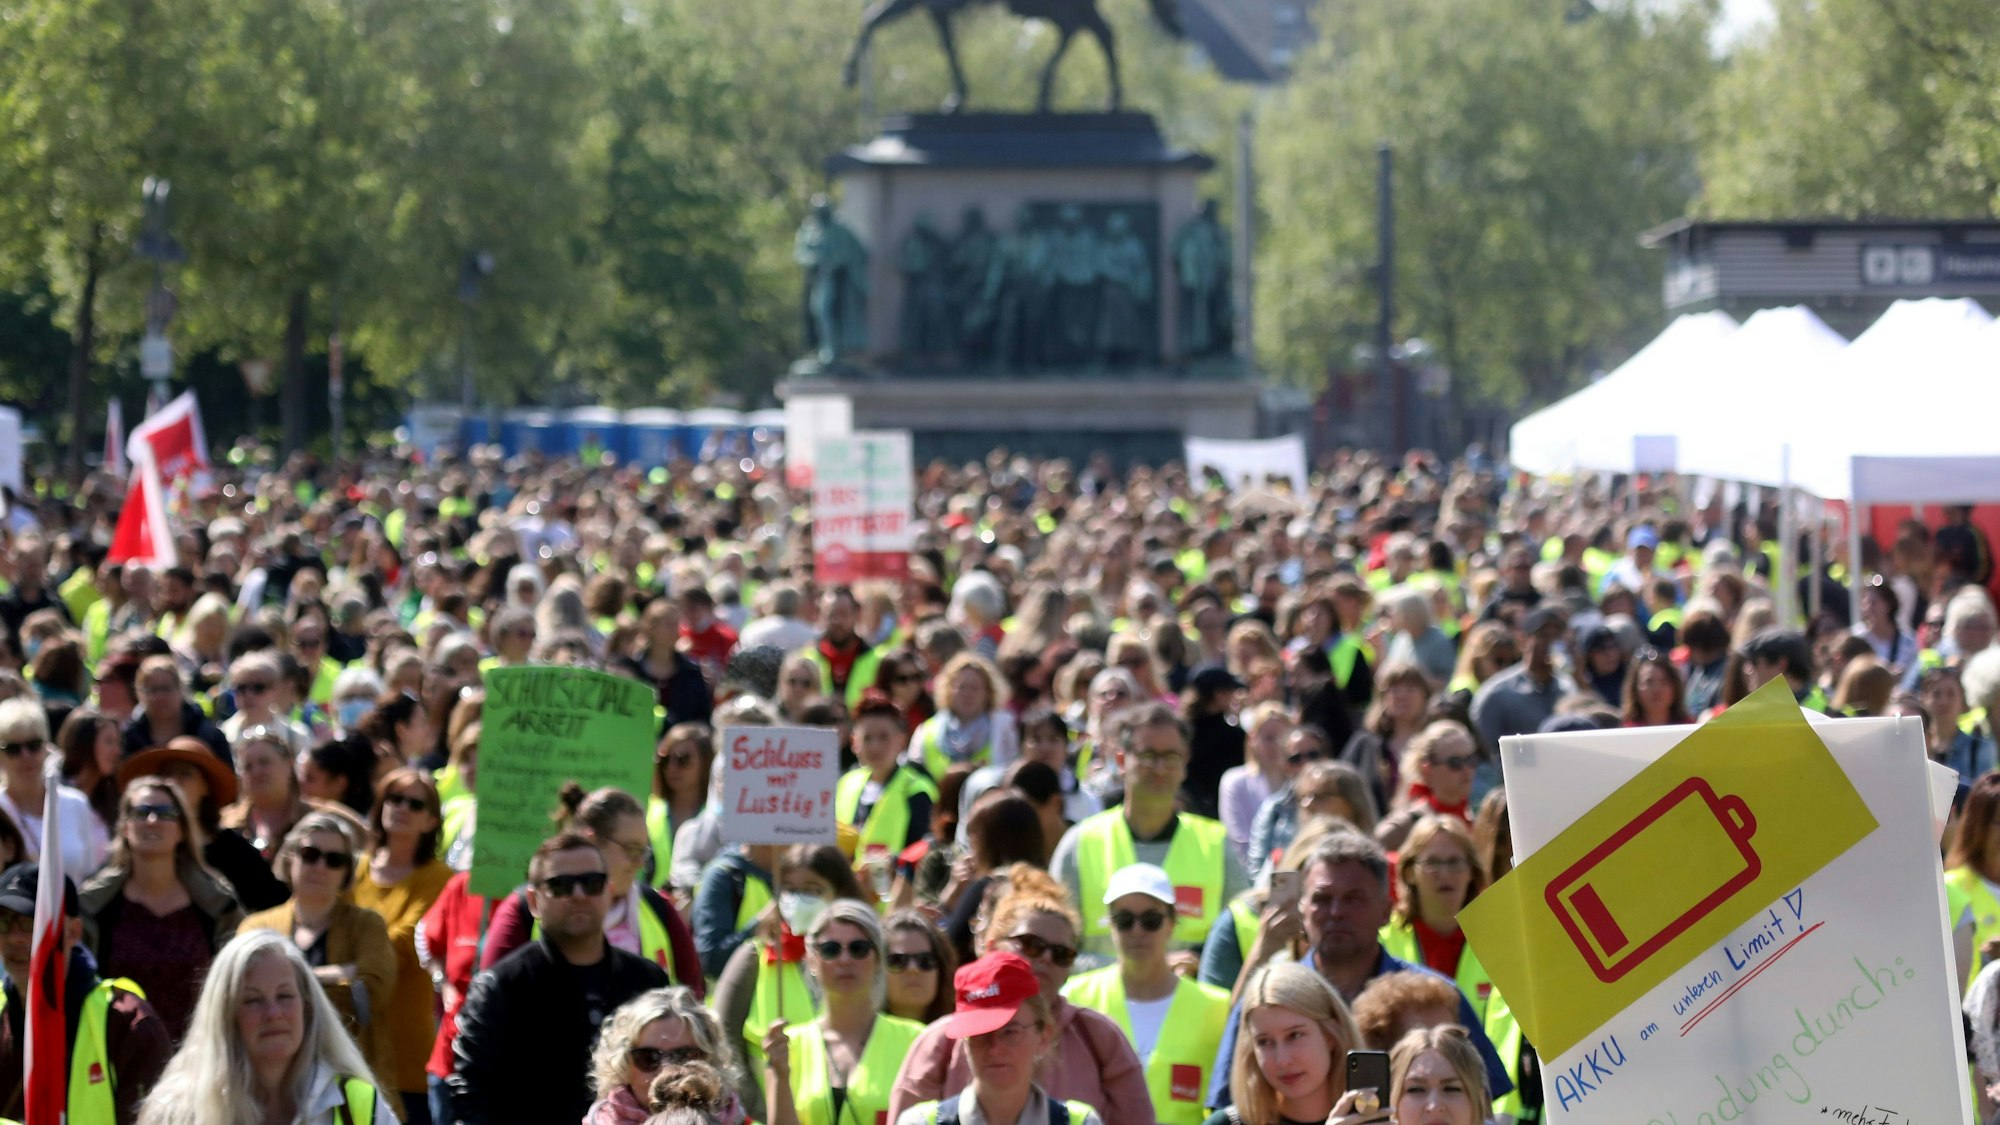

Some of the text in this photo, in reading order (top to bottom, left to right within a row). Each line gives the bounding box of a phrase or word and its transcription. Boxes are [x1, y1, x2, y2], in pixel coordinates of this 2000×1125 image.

[500, 710, 594, 740] ARBEIT
[732, 735, 823, 771] Schluss
[767, 771, 798, 788] mit
[1555, 1035, 1627, 1112] AKKU
[1640, 1021, 1659, 1041] am
[1673, 969, 1723, 1016] unteren
